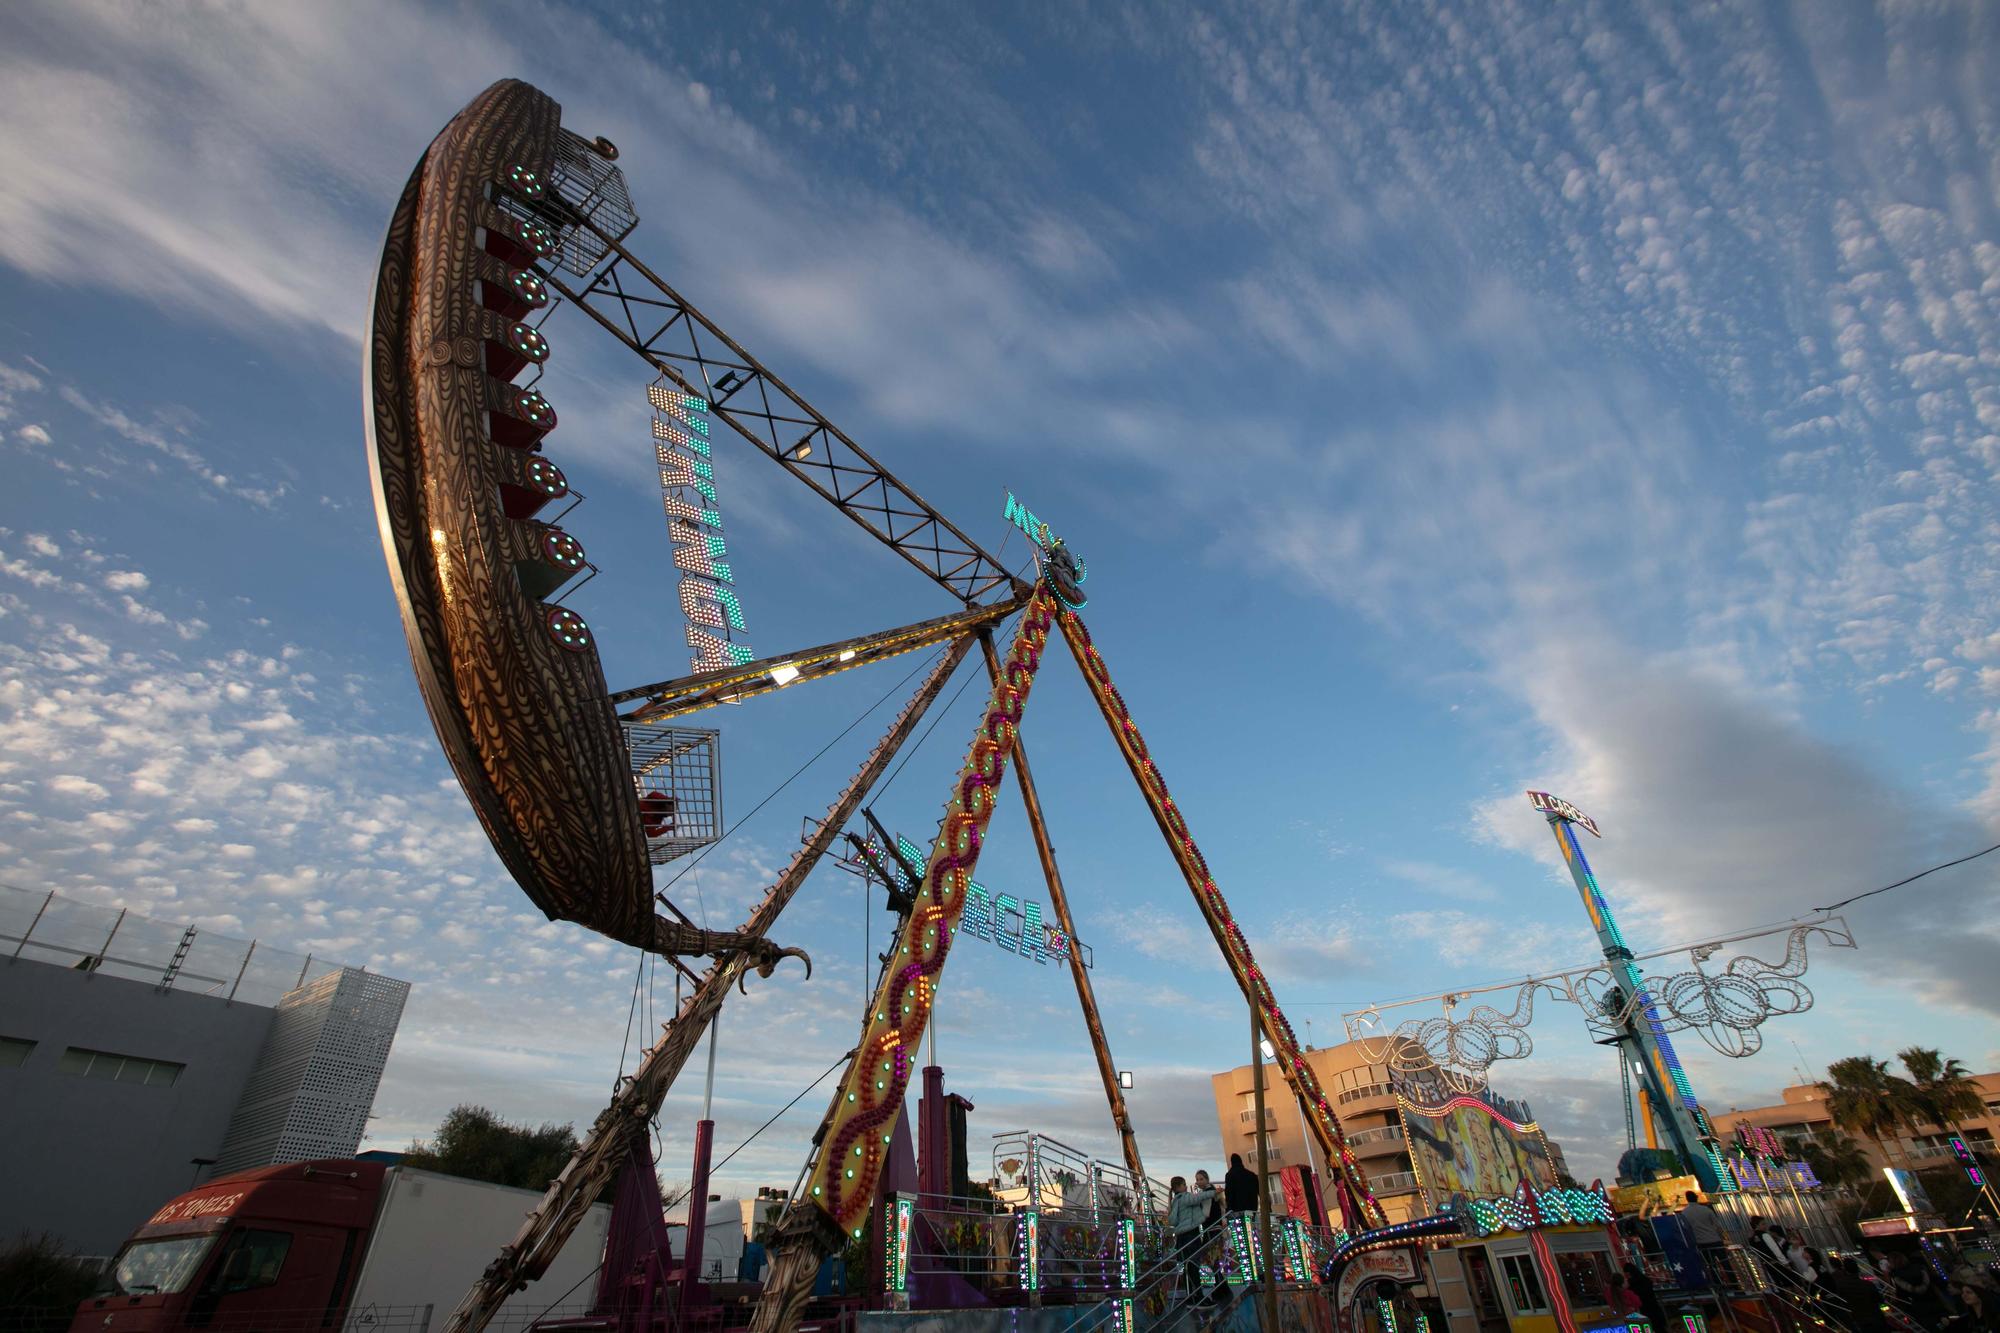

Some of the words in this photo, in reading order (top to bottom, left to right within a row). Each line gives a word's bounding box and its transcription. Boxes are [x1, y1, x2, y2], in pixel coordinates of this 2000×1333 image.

[646, 383, 755, 675] VIKINGA
[1530, 793, 1548, 809] LA
[177, 1192, 245, 1218] TONELES
